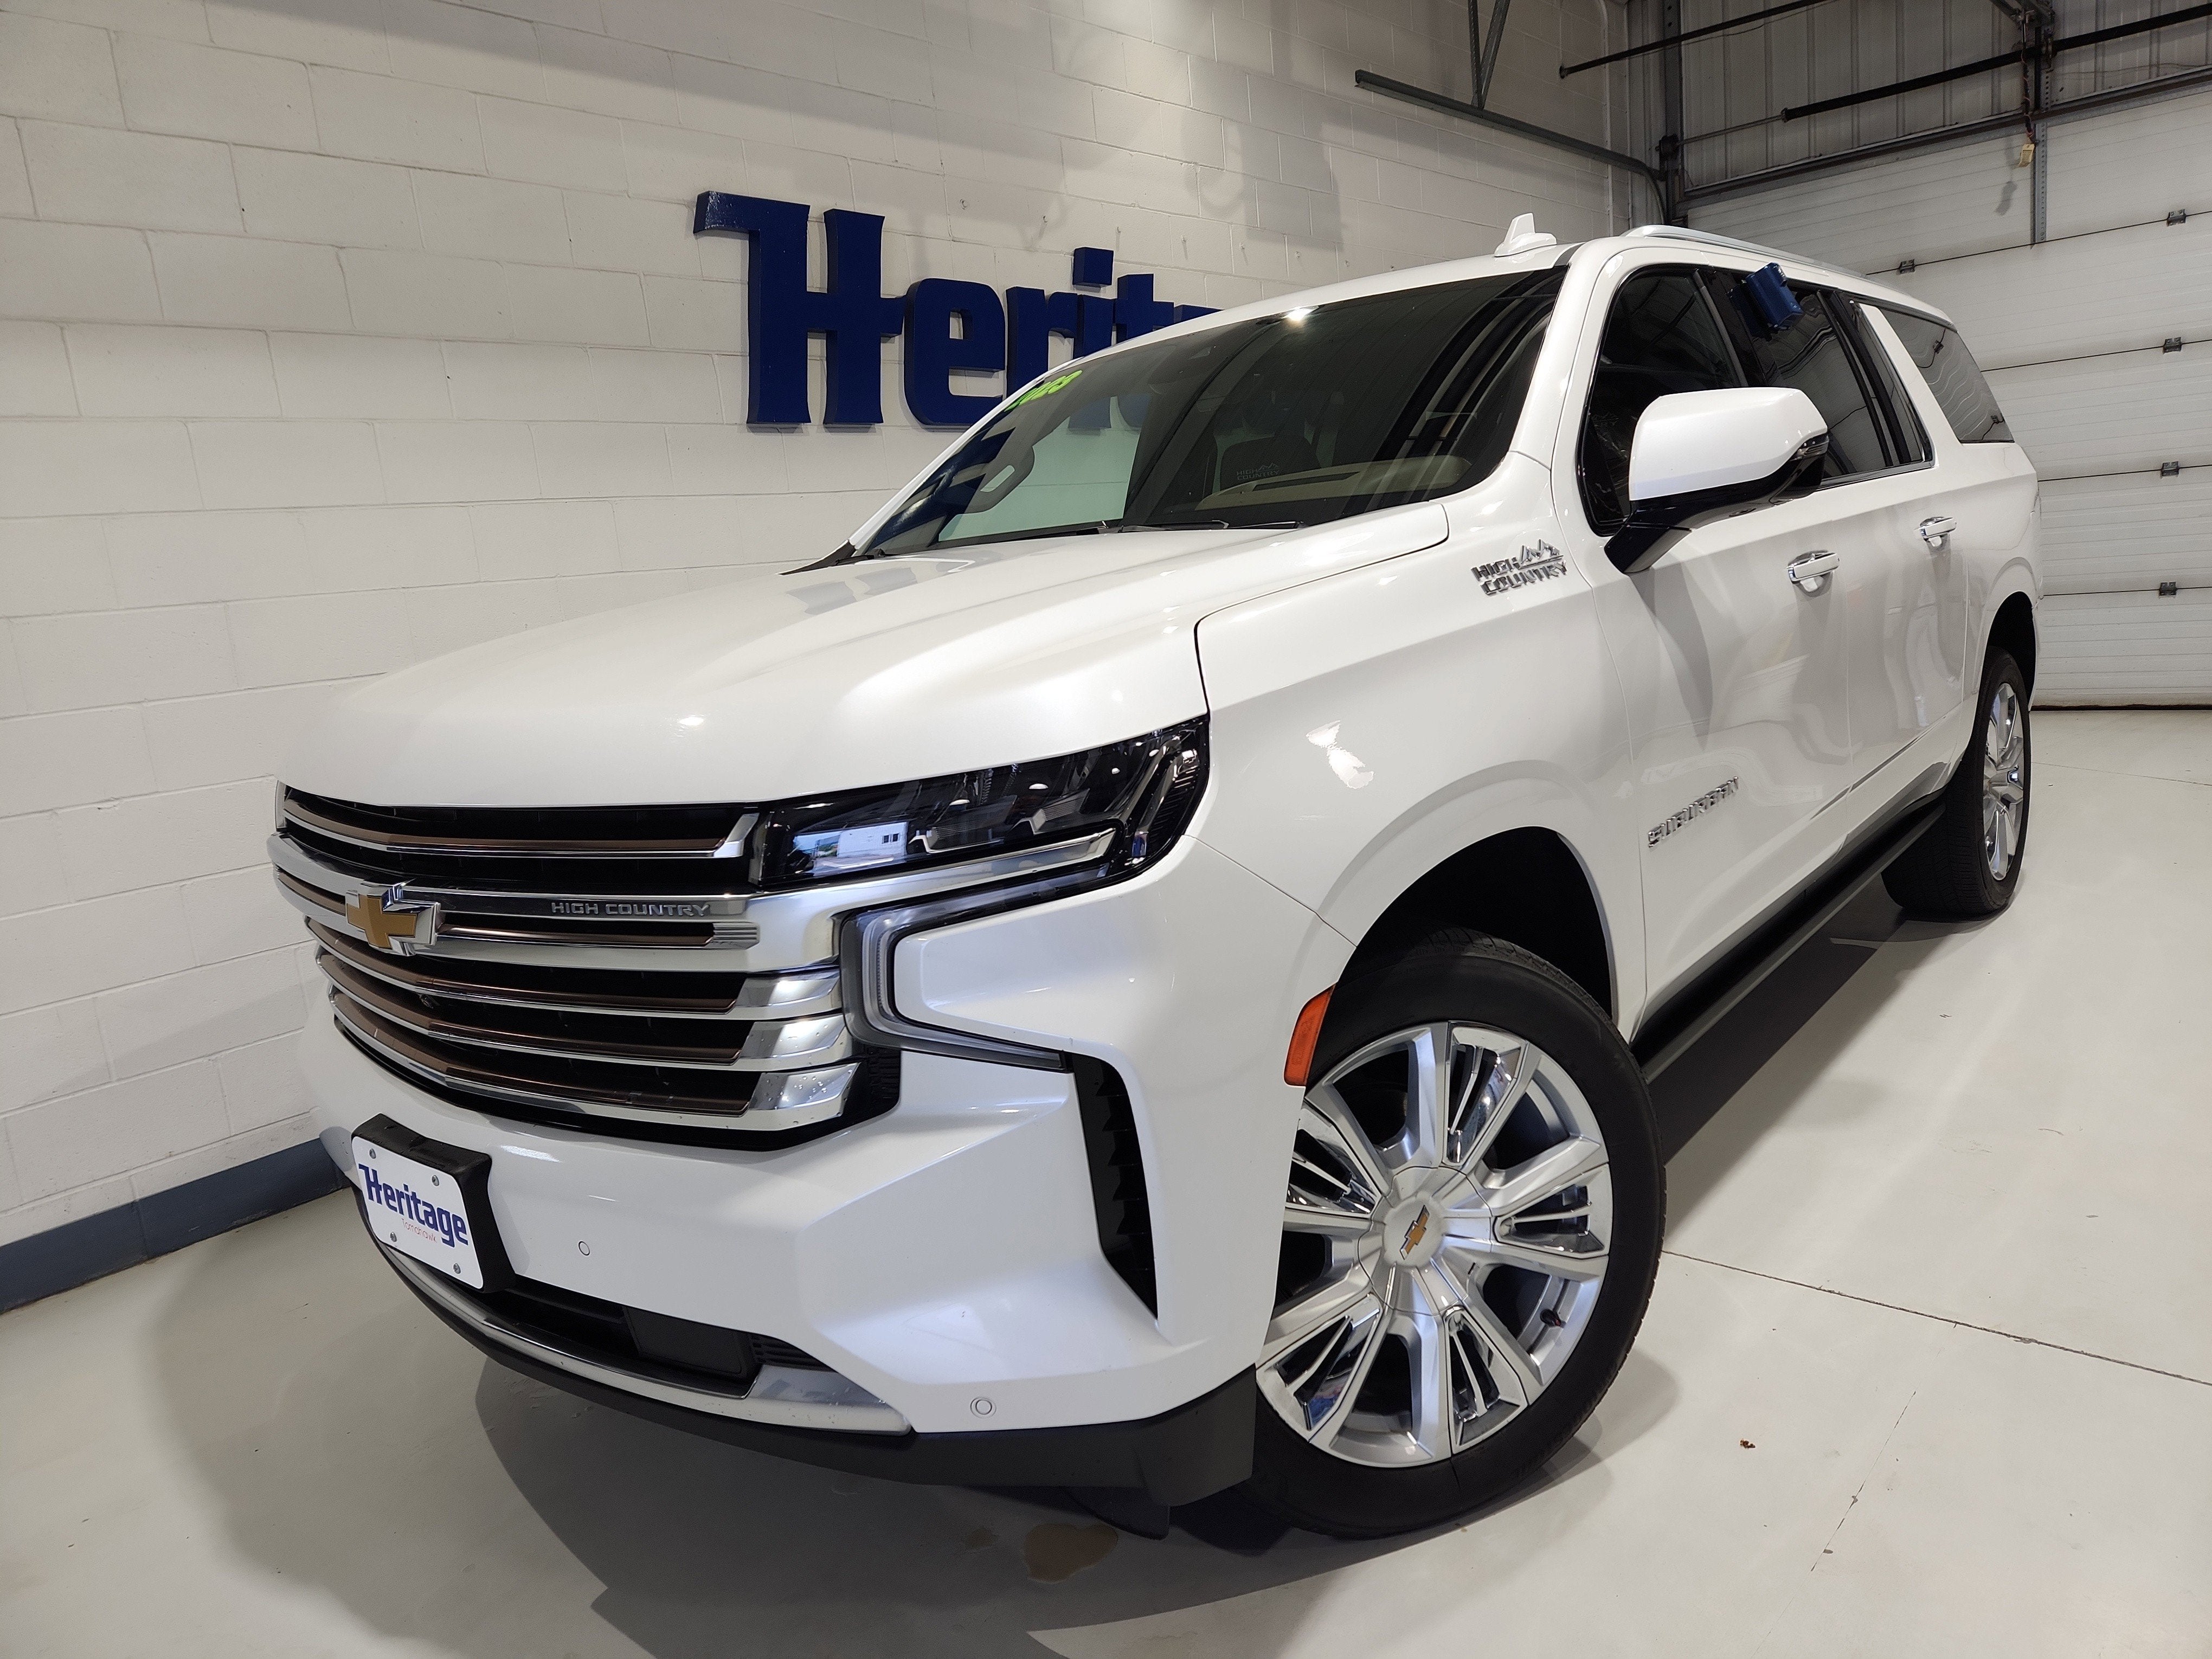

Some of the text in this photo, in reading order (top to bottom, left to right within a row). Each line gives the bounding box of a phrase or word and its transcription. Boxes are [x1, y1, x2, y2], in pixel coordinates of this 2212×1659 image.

[693, 190, 1224, 432] Herit
[1471, 556, 1521, 581] HIGH
[1481, 561, 1567, 596] COUNTRY
[1648, 776, 1739, 848] SUBURBAN
[551, 902, 710, 916] HIGH COUNTRY
[358, 1163, 468, 1248] Heritage
[401, 1218, 438, 1244] Tomahawk
